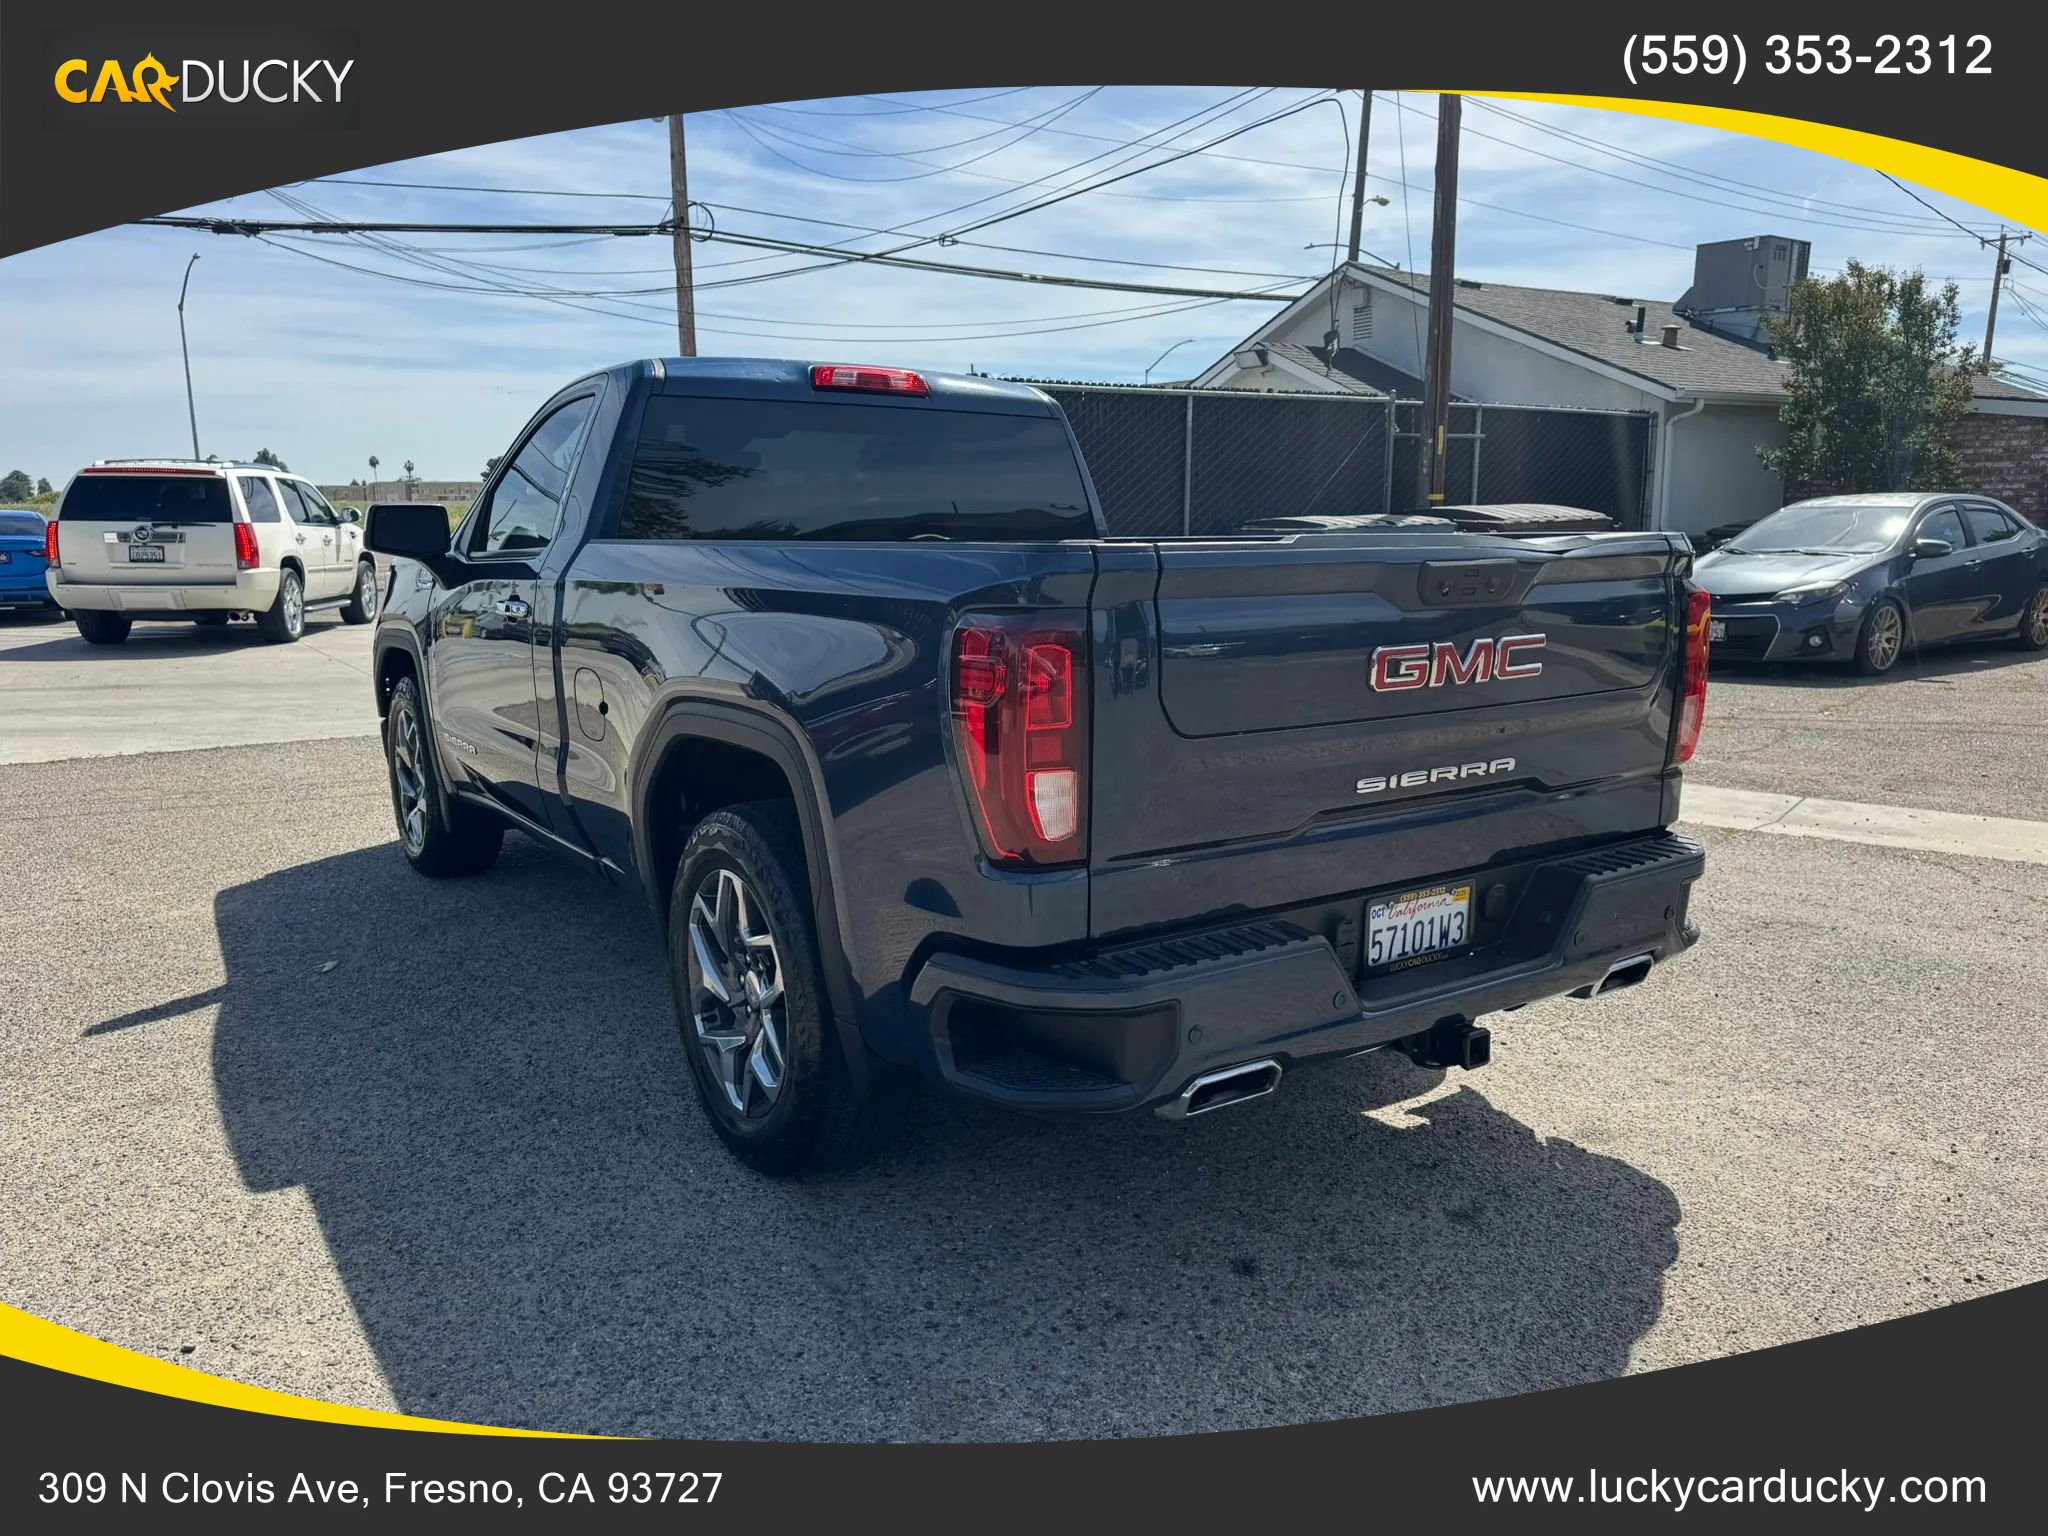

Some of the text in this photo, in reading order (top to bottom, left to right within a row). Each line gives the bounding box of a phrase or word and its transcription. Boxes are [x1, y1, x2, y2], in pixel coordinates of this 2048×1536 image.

[1370, 633, 1546, 691] GMC
[444, 733, 475, 755] SIERRA
[1356, 757, 1516, 794] SIERRA
[1372, 907, 1385, 919] OCT
[1388, 897, 1453, 920] California
[1371, 911, 1465, 964] 57101W3
